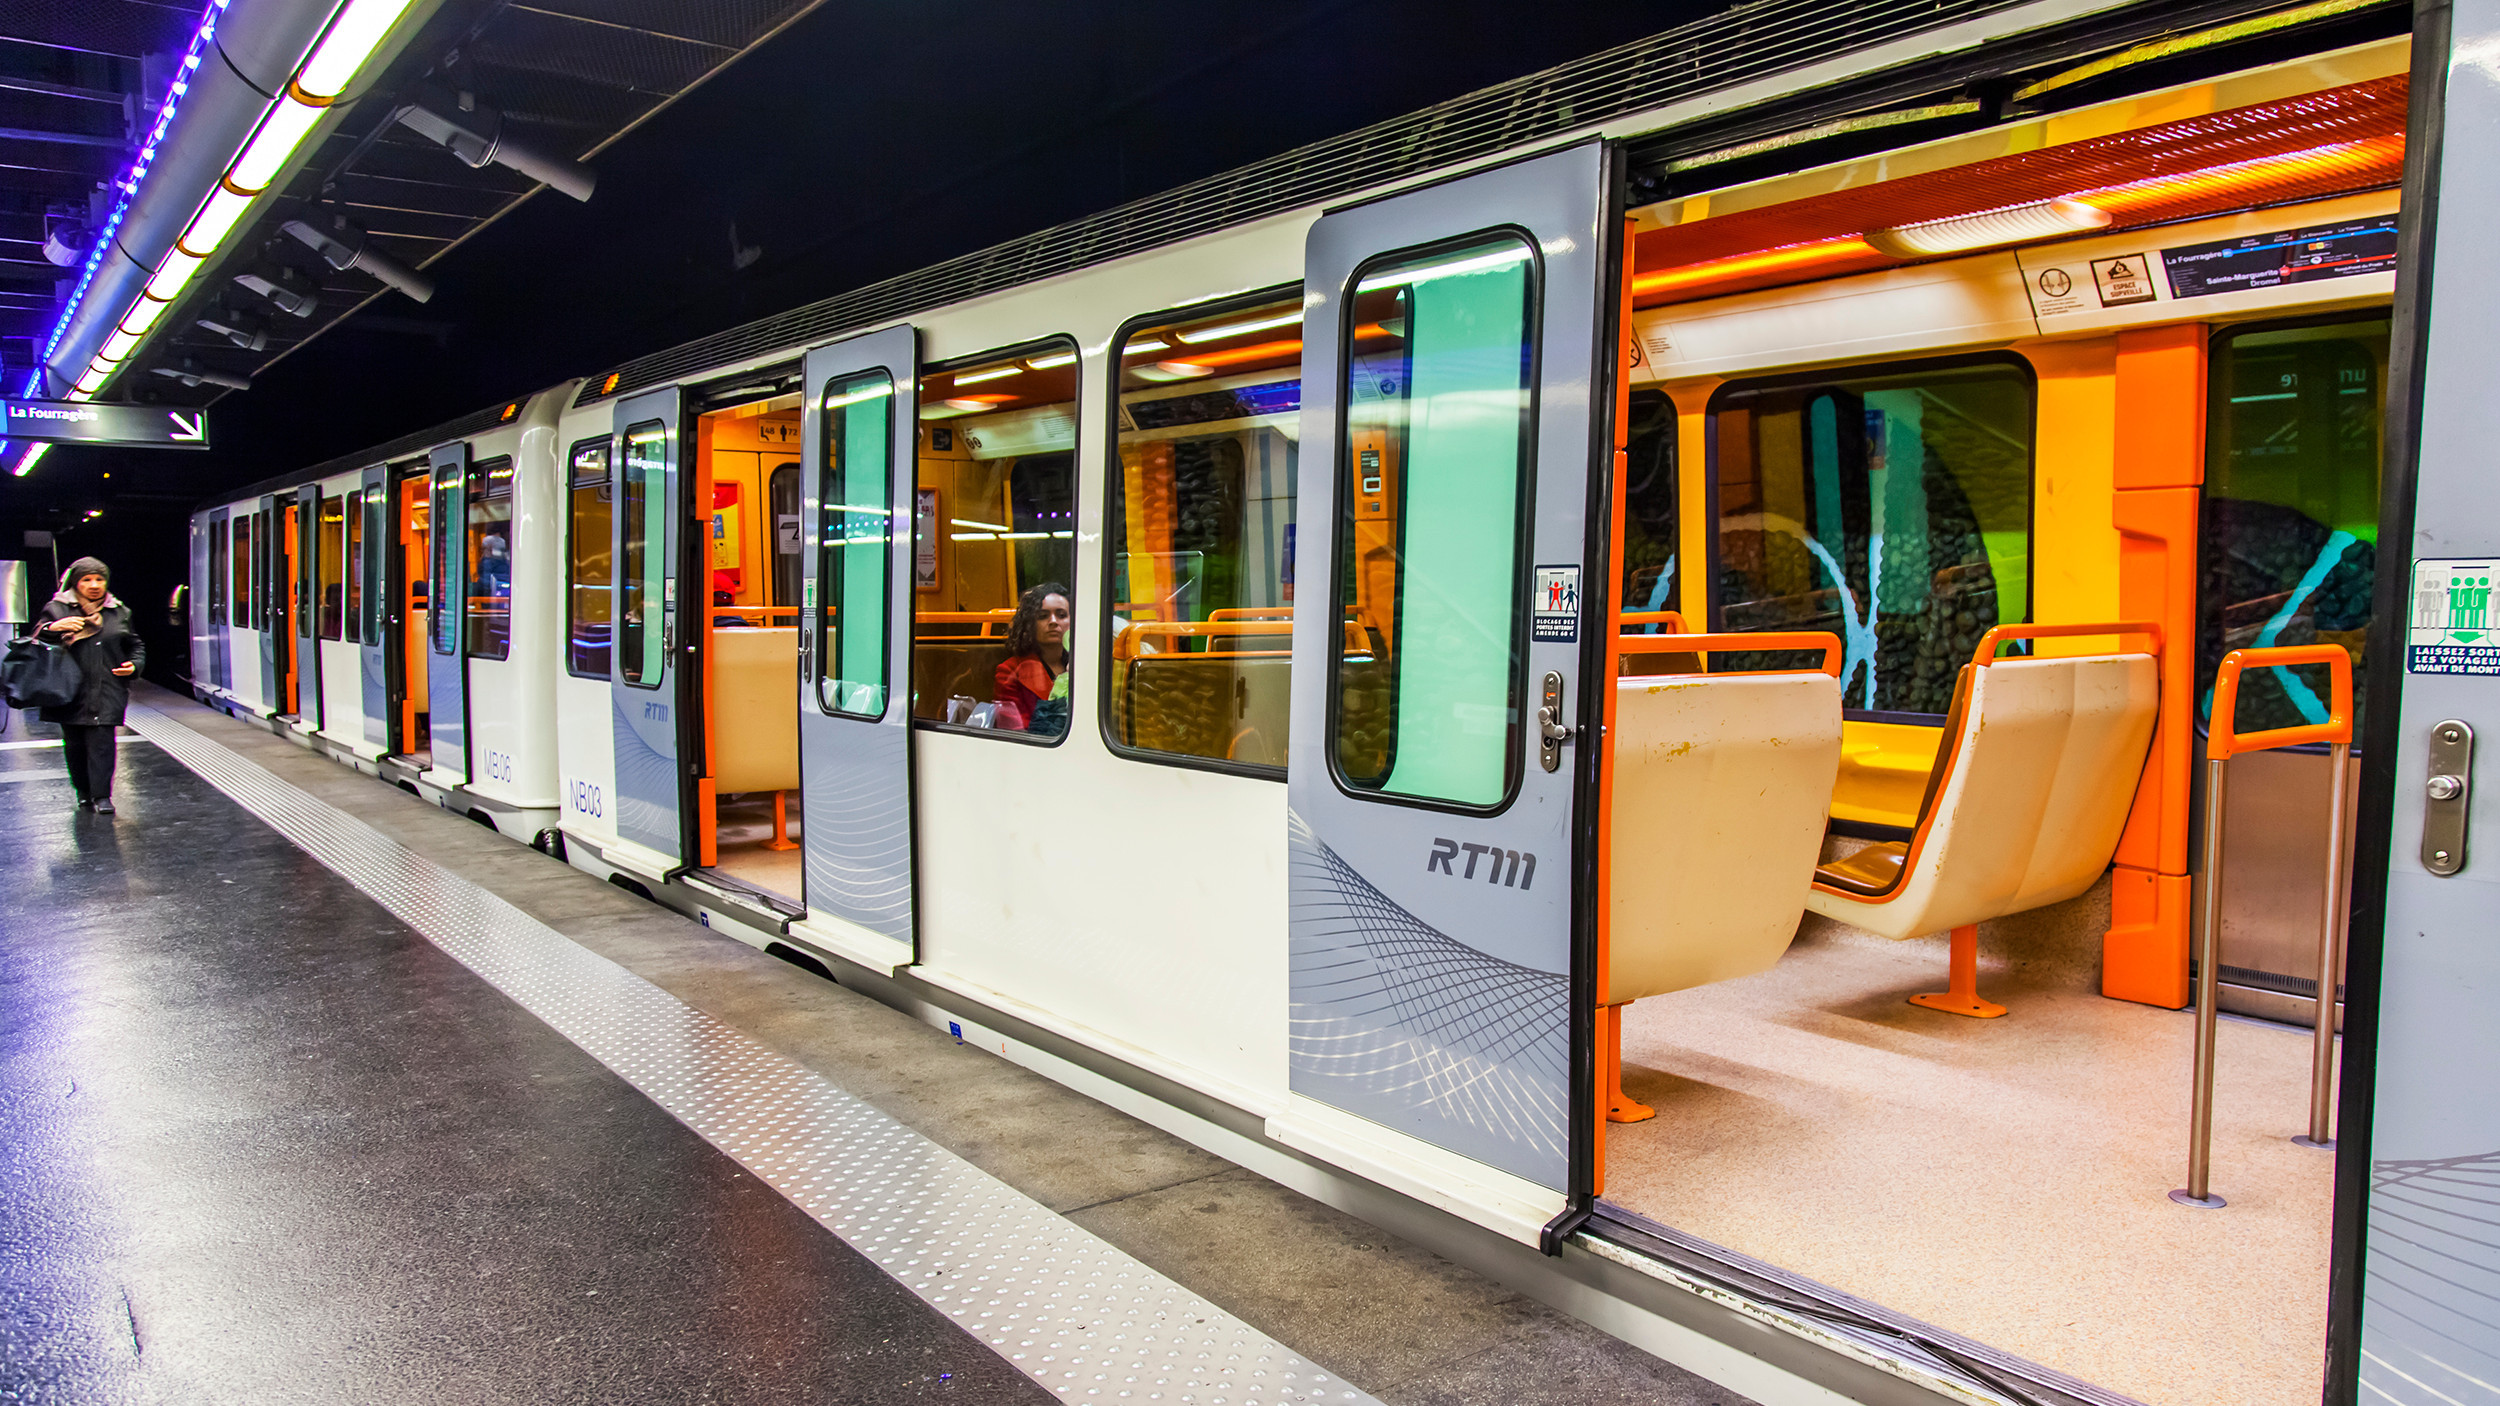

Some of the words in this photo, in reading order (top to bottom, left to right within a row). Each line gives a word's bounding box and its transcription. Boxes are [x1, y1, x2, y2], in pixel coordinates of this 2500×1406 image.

[2178, 251, 2222, 263] Fourragère
[2206, 270, 2279, 284] Sainte-Marguerite
[2250, 277, 2281, 287] Dromel
[2113, 282, 2136, 290] ESPACE
[10, 406, 27, 418] La
[28, 407, 99, 422] Fourragère
[788, 428, 798, 436] 72
[2415, 646, 2466, 656] LAISSEZ
[2414, 655, 2437, 664] LES
[2440, 656, 2500, 665] VOYAGEU
[2413, 663, 2449, 673] AVANT
[2450, 664, 2466, 673] DE
[483, 747, 512, 784] MB06
[569, 777, 602, 819] NB03
[1426, 836, 1538, 891] RTM
